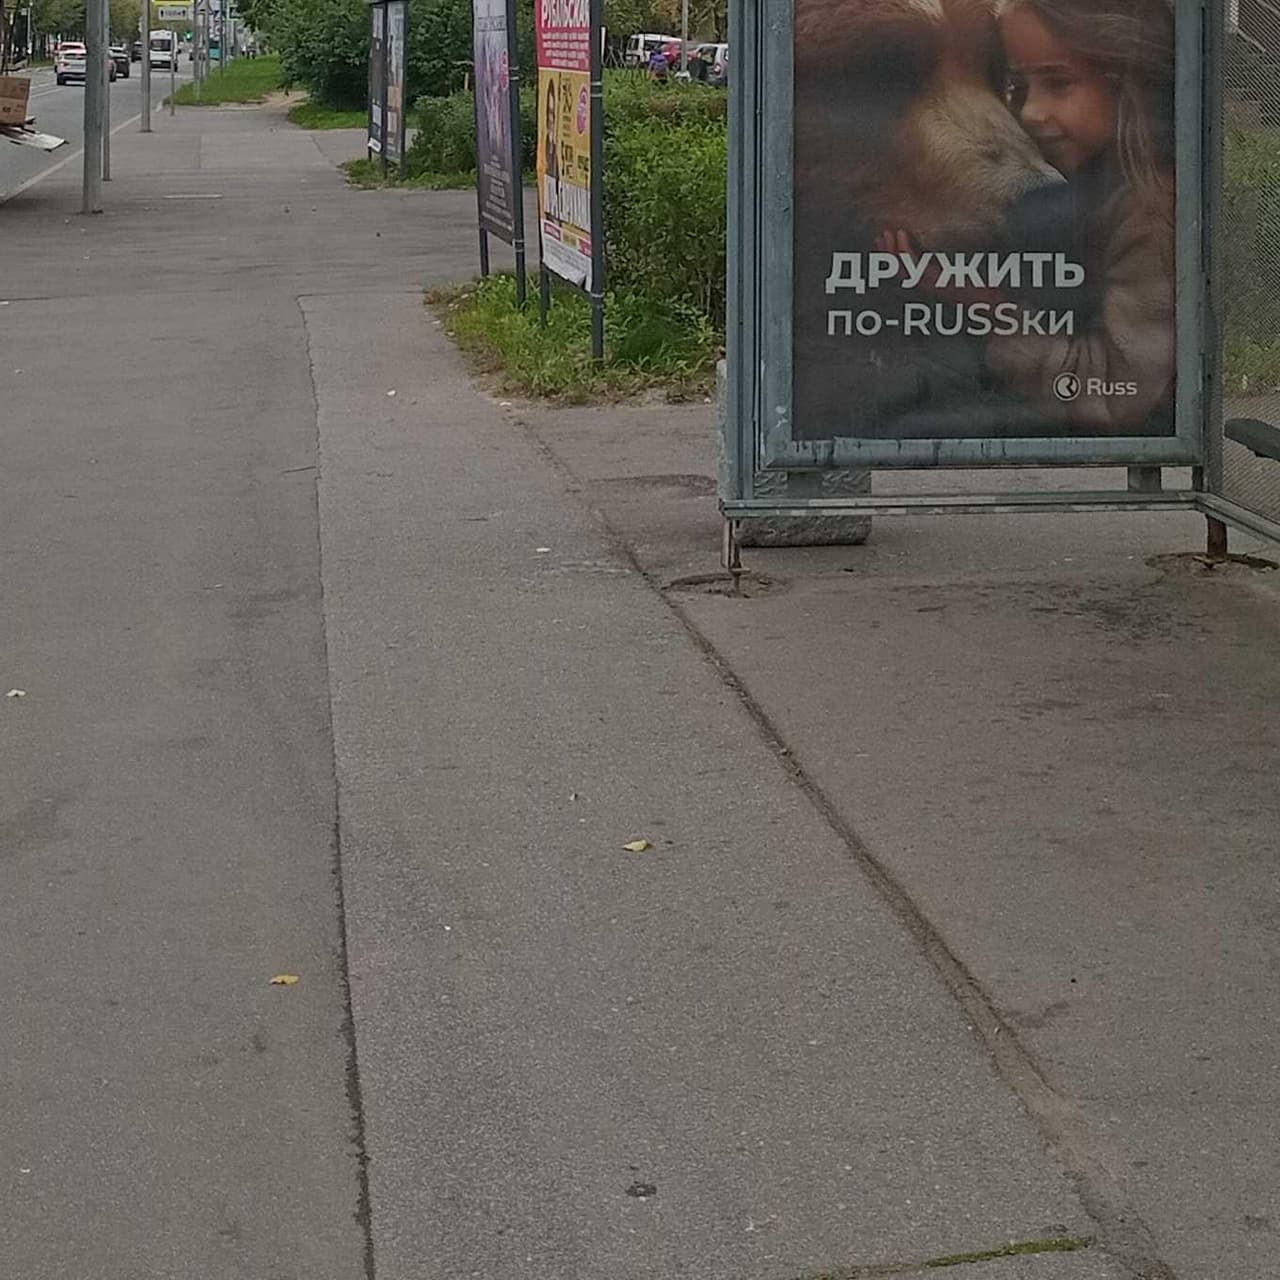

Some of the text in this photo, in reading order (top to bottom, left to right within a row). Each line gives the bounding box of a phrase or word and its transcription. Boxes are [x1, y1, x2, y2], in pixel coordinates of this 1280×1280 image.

[824, 252, 1086, 295] ДРУЖИТЬ
[827, 302, 1075, 336] по-RUSSки
[1086, 377, 1138, 396] Russ
